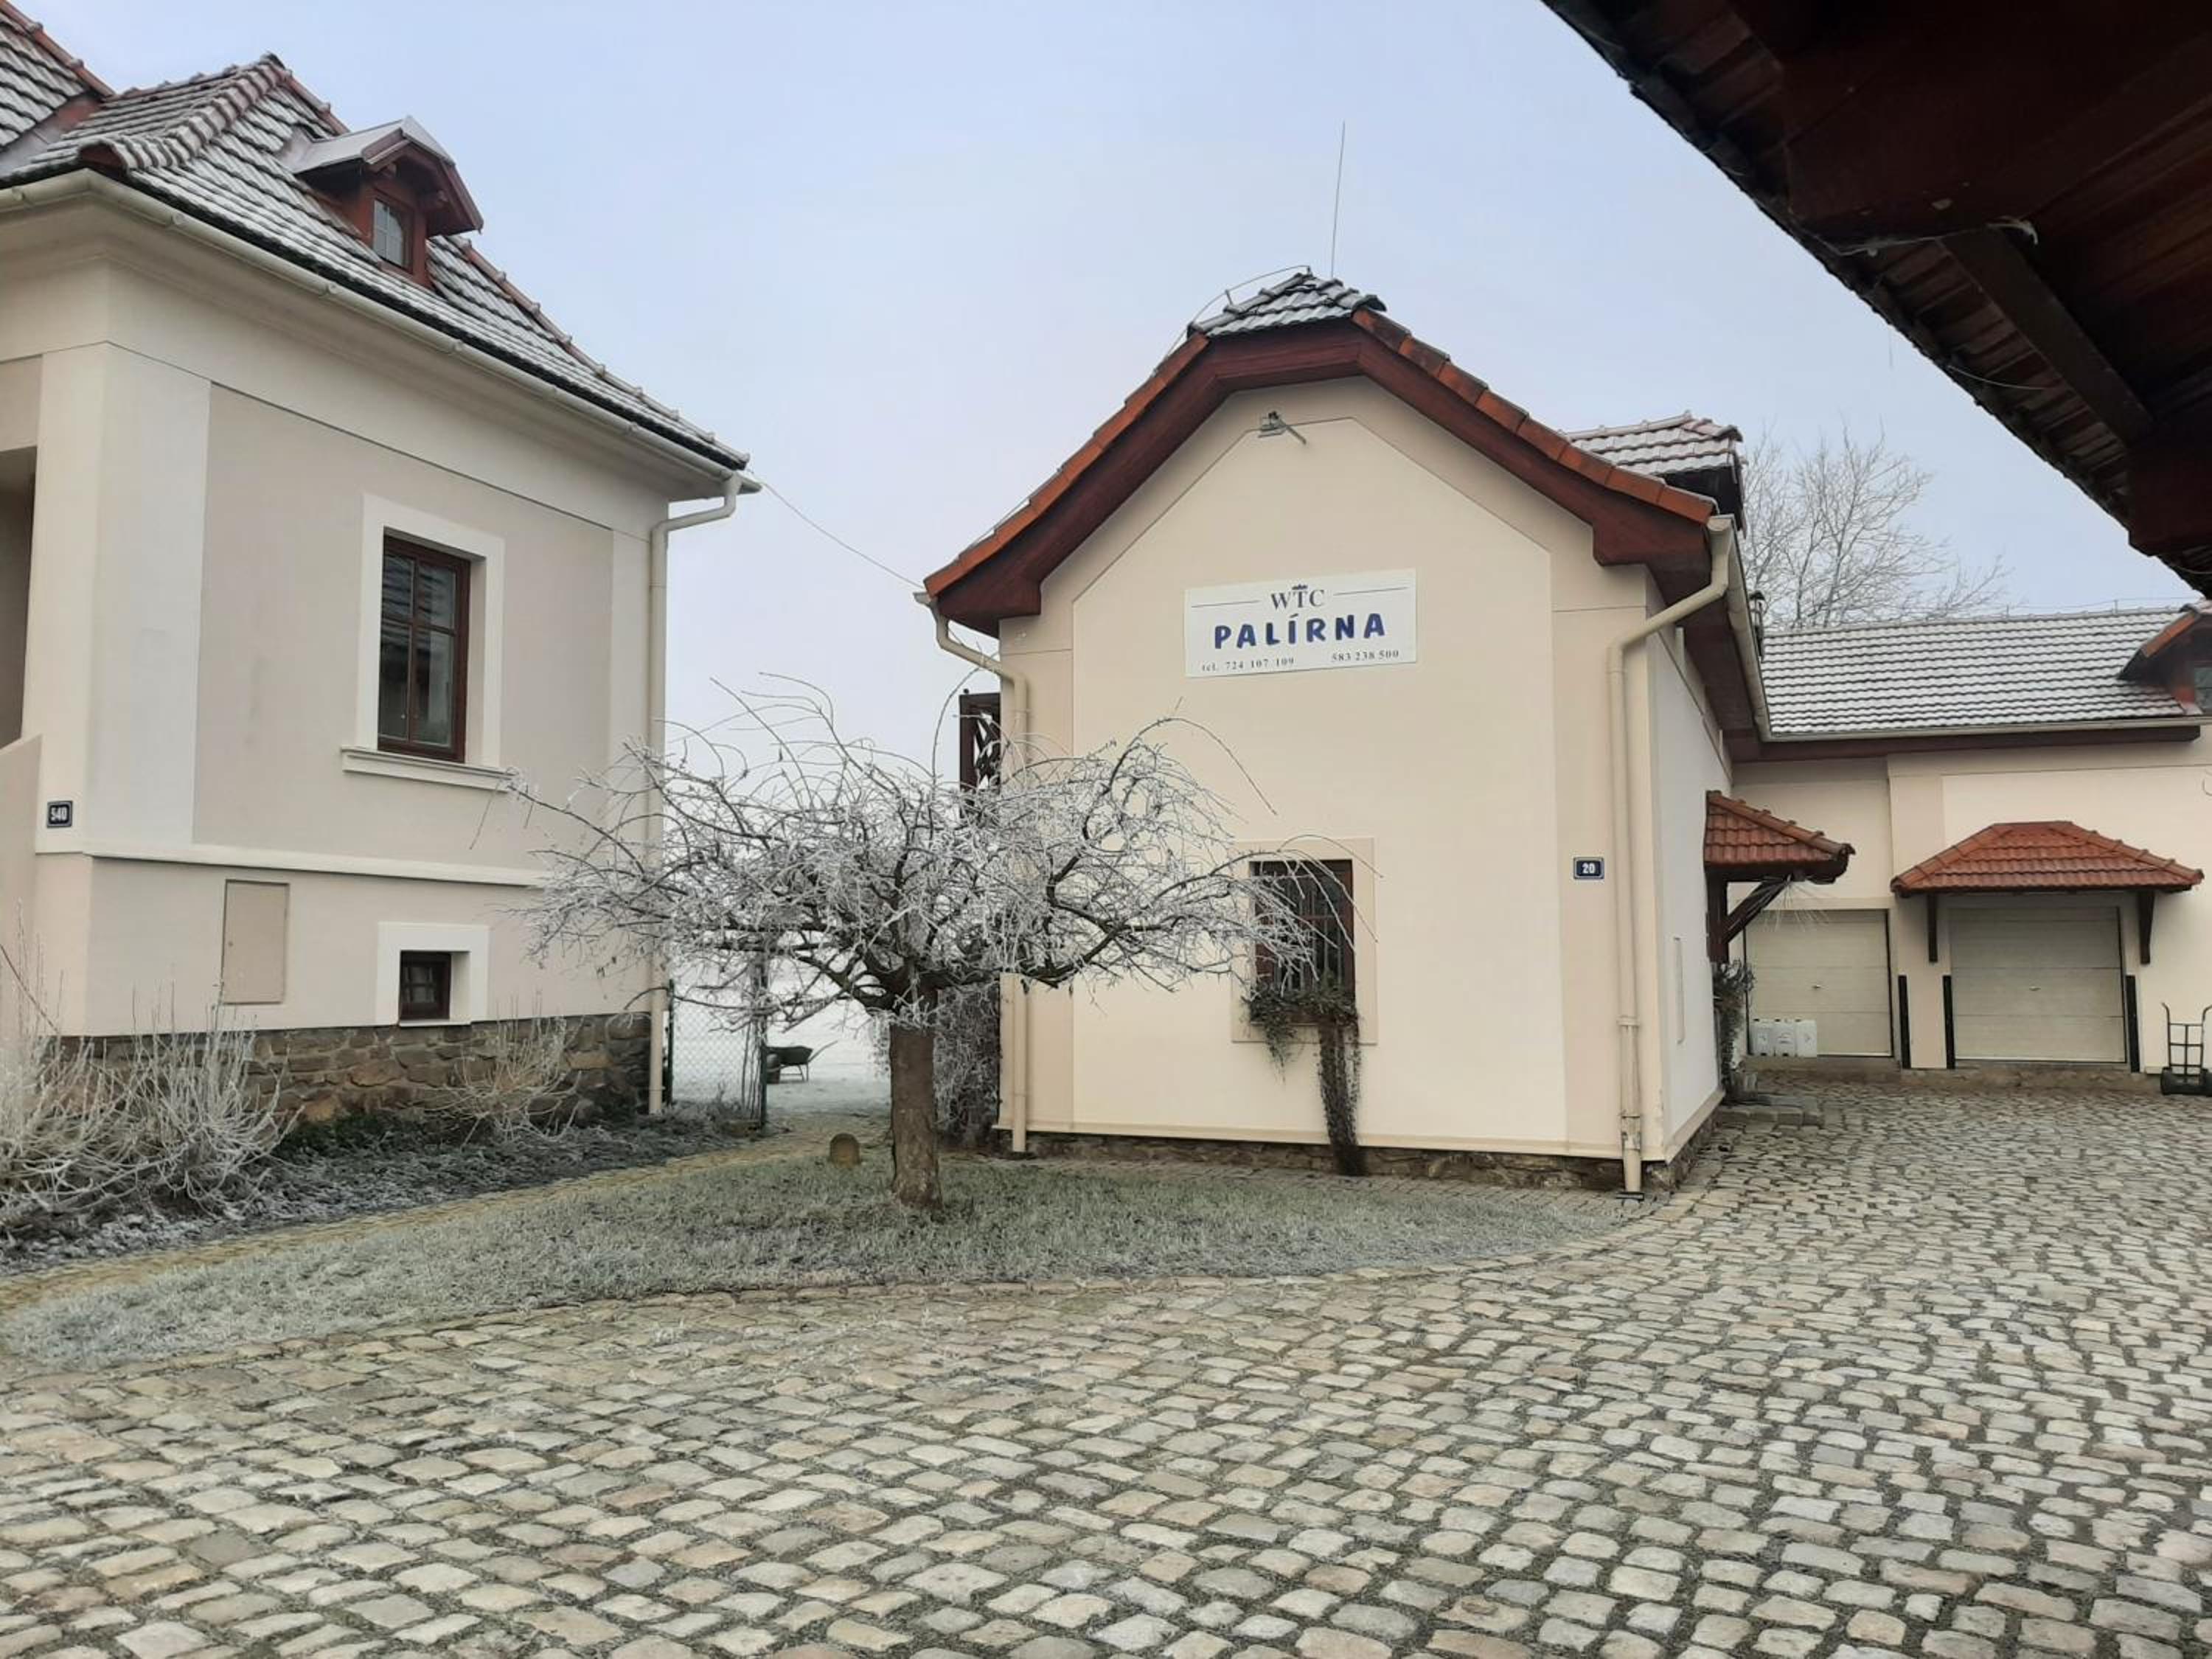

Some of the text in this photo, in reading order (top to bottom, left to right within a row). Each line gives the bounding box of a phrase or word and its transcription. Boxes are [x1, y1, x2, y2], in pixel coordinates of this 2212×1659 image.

[1270, 589, 1325, 611] WTC
[1214, 613, 1385, 650] PALÍRNA
[50, 807, 68, 821] 540
[1582, 862, 1596, 874] 20
